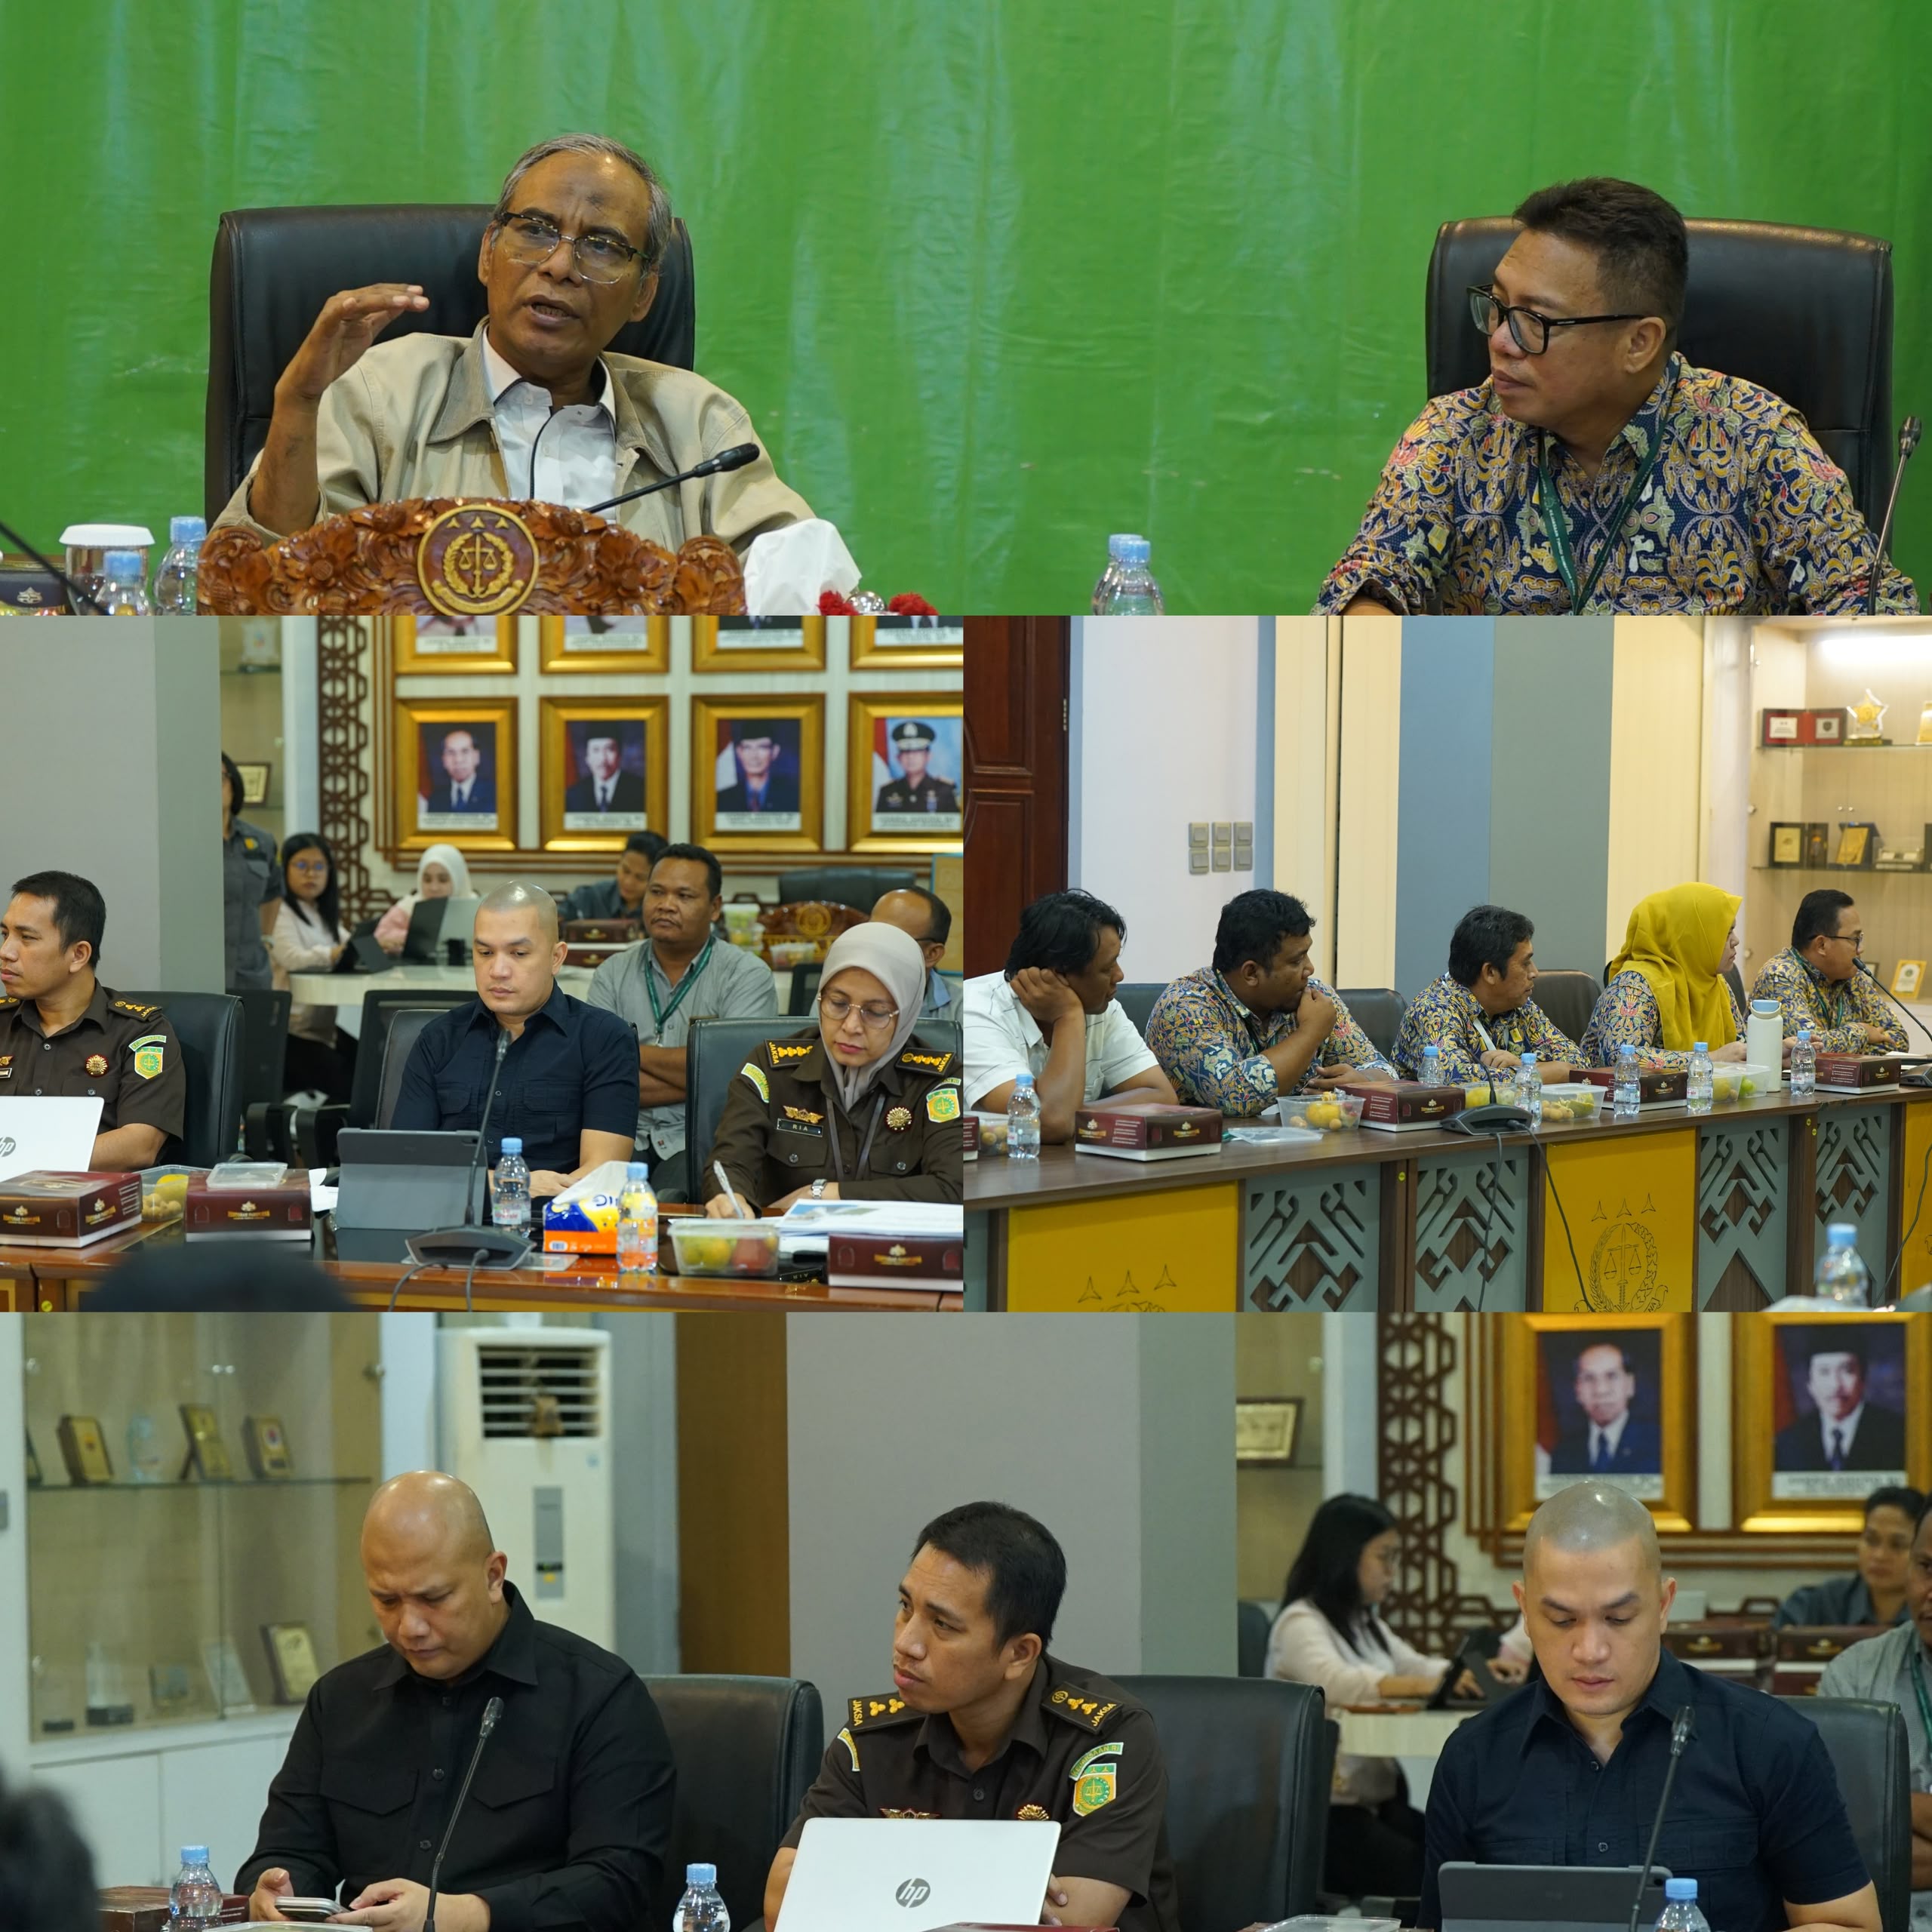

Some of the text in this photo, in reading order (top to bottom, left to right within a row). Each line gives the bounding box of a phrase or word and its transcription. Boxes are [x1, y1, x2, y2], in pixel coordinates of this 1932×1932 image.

[769, 1041, 779, 1064] JAKSA
[937, 1053, 952, 1072] JAKSA
[853, 1700, 863, 1727] JAKSA
[1091, 1703, 1117, 1727] JAKSA
[896, 1878, 931, 1908] hp
